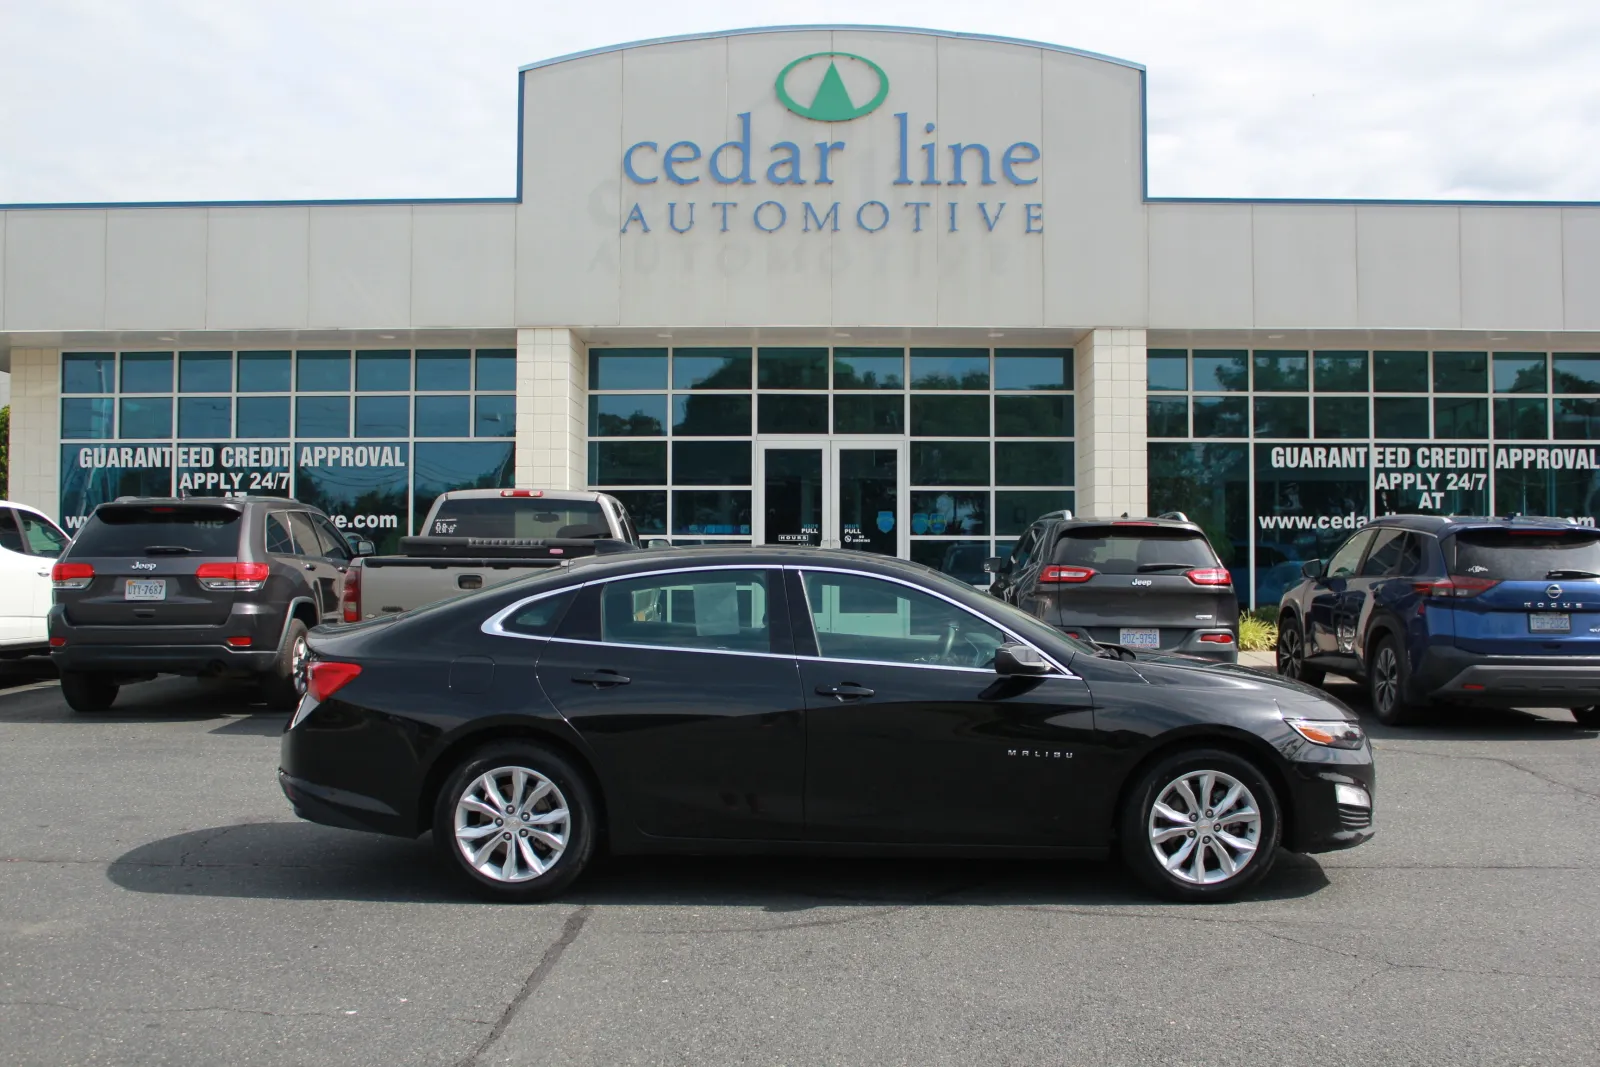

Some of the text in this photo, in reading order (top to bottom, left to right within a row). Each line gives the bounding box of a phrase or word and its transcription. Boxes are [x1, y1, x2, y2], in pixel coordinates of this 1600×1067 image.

[621, 111, 1042, 187] cedar line
[620, 200, 1044, 234] AUTOMOTIVE
[79, 445, 405, 468] GUARANTEED CREDIT APPROVAL
[1271, 447, 1600, 470] GUARANTEED CREDIT APPROVAL
[179, 472, 291, 490] APPLY 24/7
[1375, 473, 1487, 491] APPLY 24/7
[1418, 492, 1444, 509] AT
[131, 561, 157, 571] Jeep
[1131, 578, 1152, 587] Jeep
[1007, 749, 1073, 759] MALIBU
